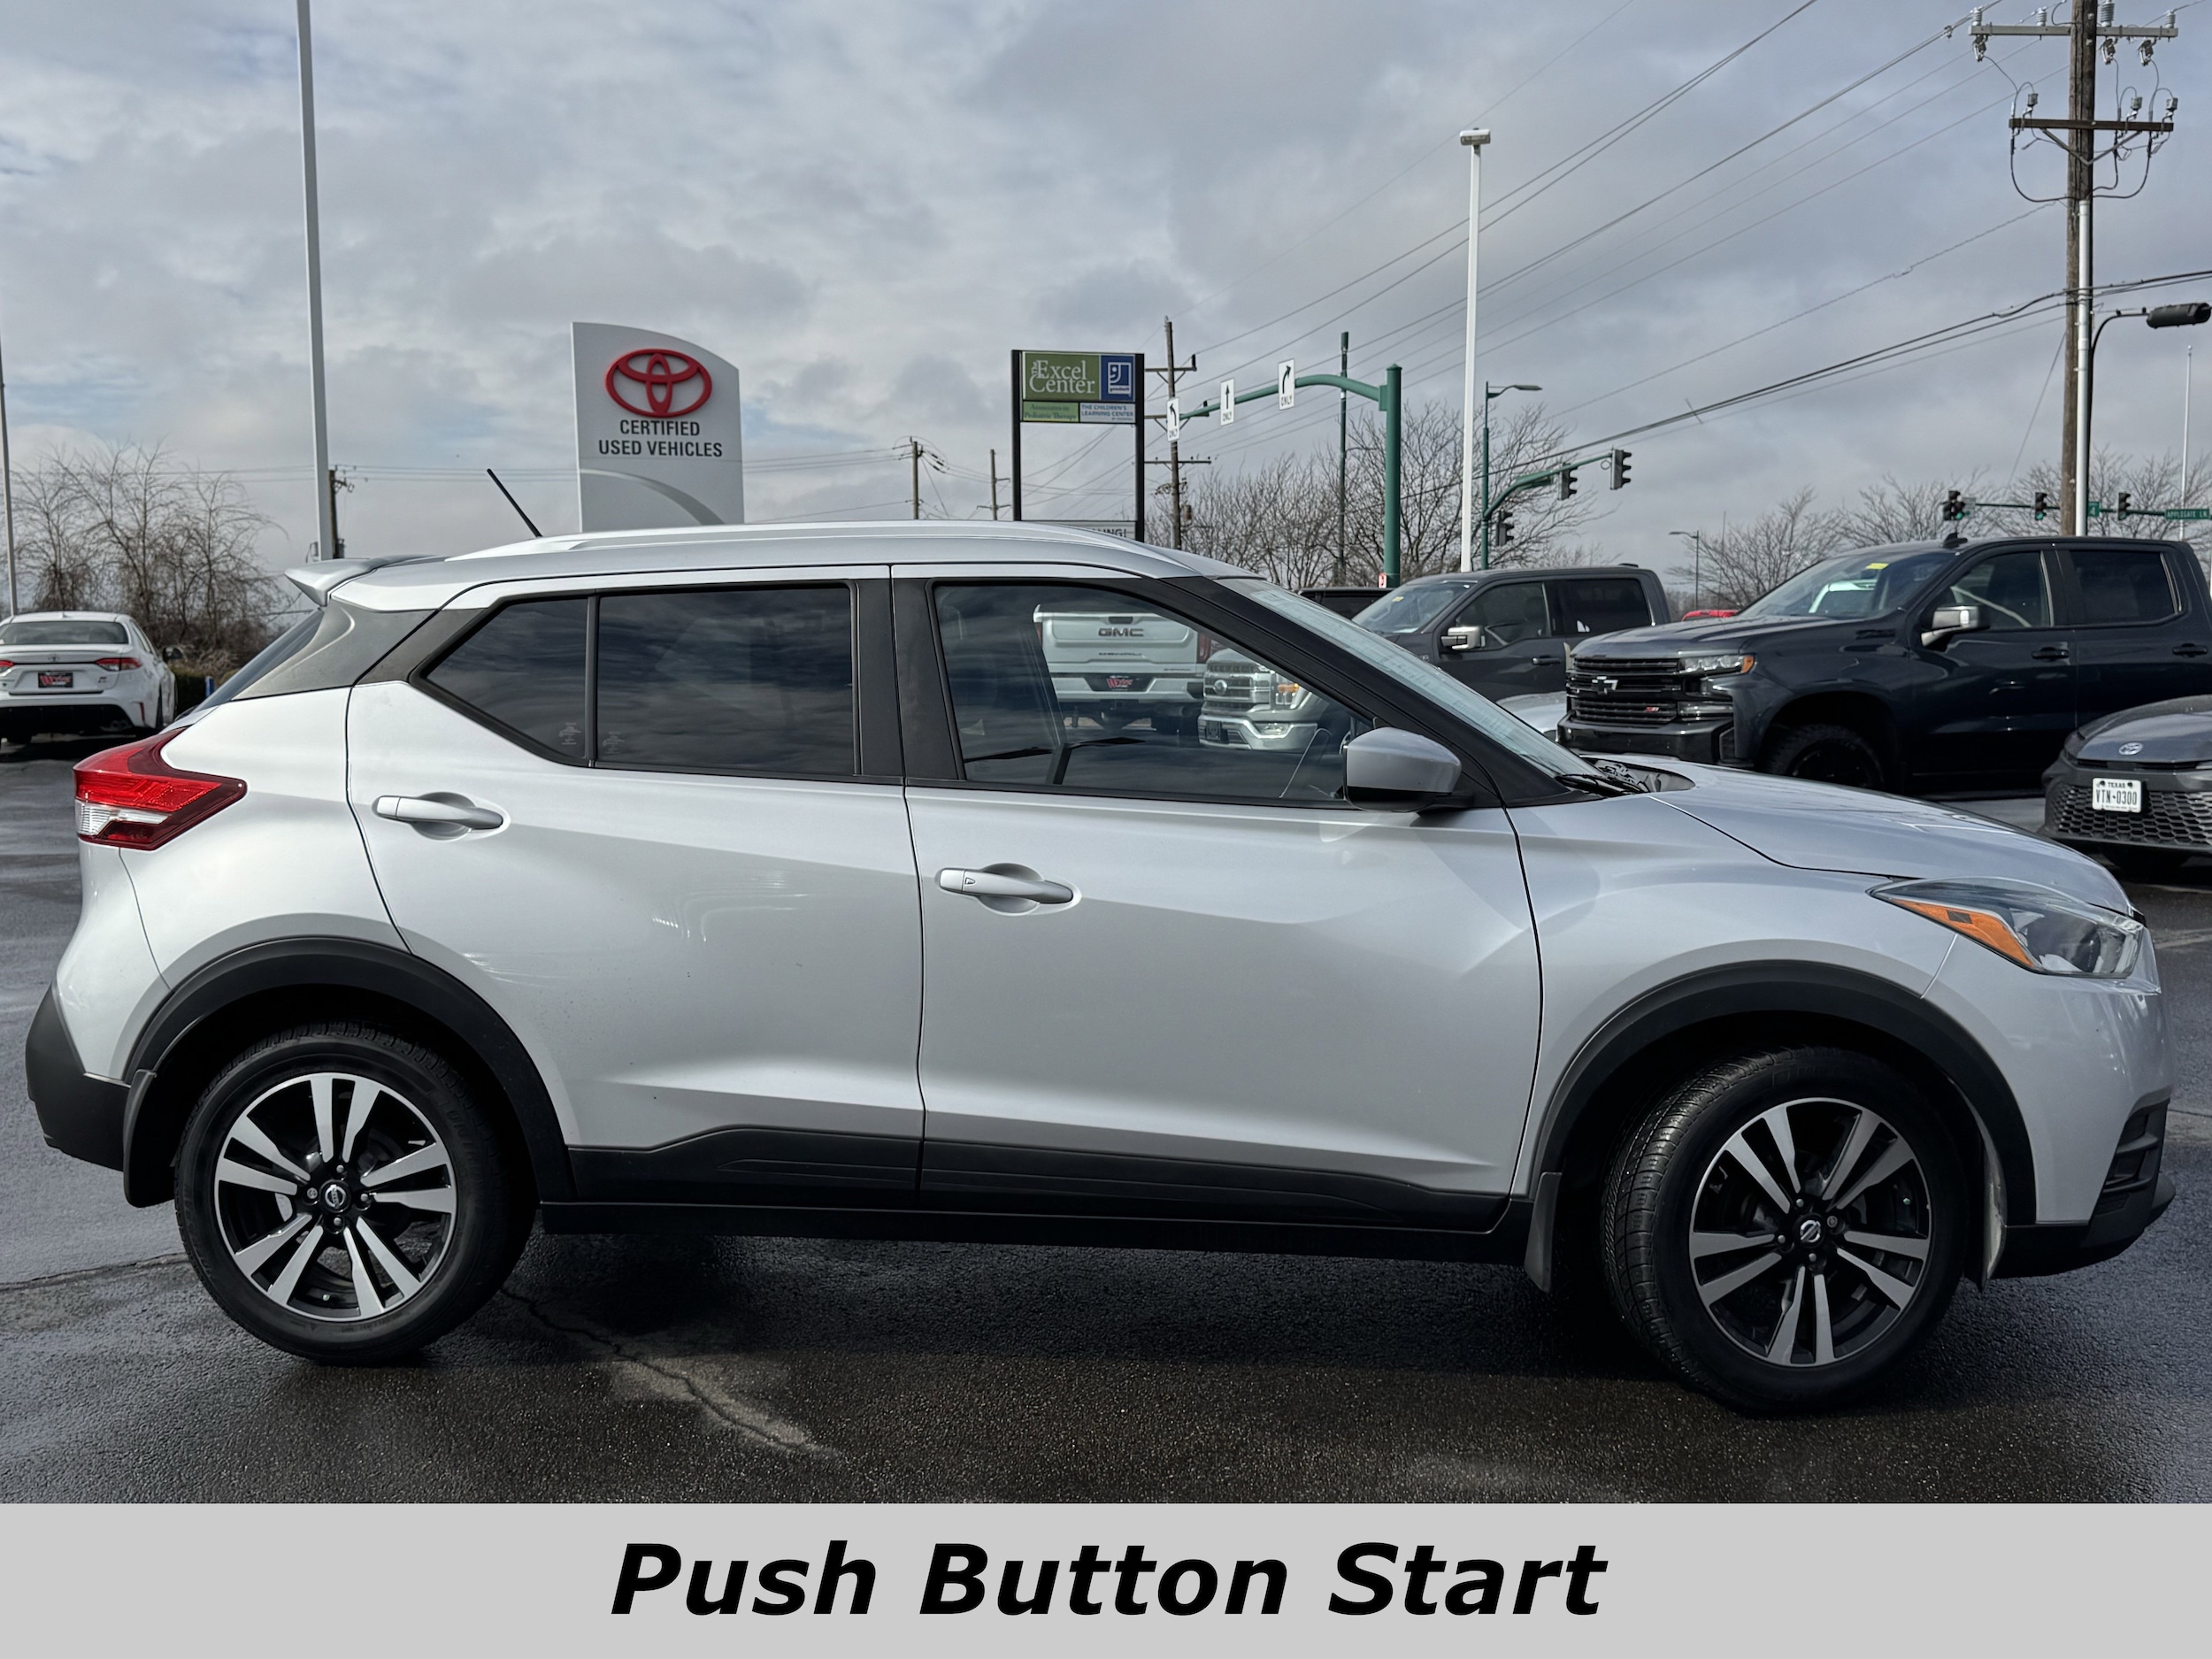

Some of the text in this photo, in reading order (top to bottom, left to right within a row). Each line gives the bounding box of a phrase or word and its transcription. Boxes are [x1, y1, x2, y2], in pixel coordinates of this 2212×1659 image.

[1036, 360, 1087, 380] Excel
[1029, 373, 1095, 394] Center
[1281, 395, 1292, 406] ONLY
[619, 419, 701, 436] CERTIFIED
[598, 440, 723, 457] USED VEHICLES
[1098, 627, 1144, 637] GMC
